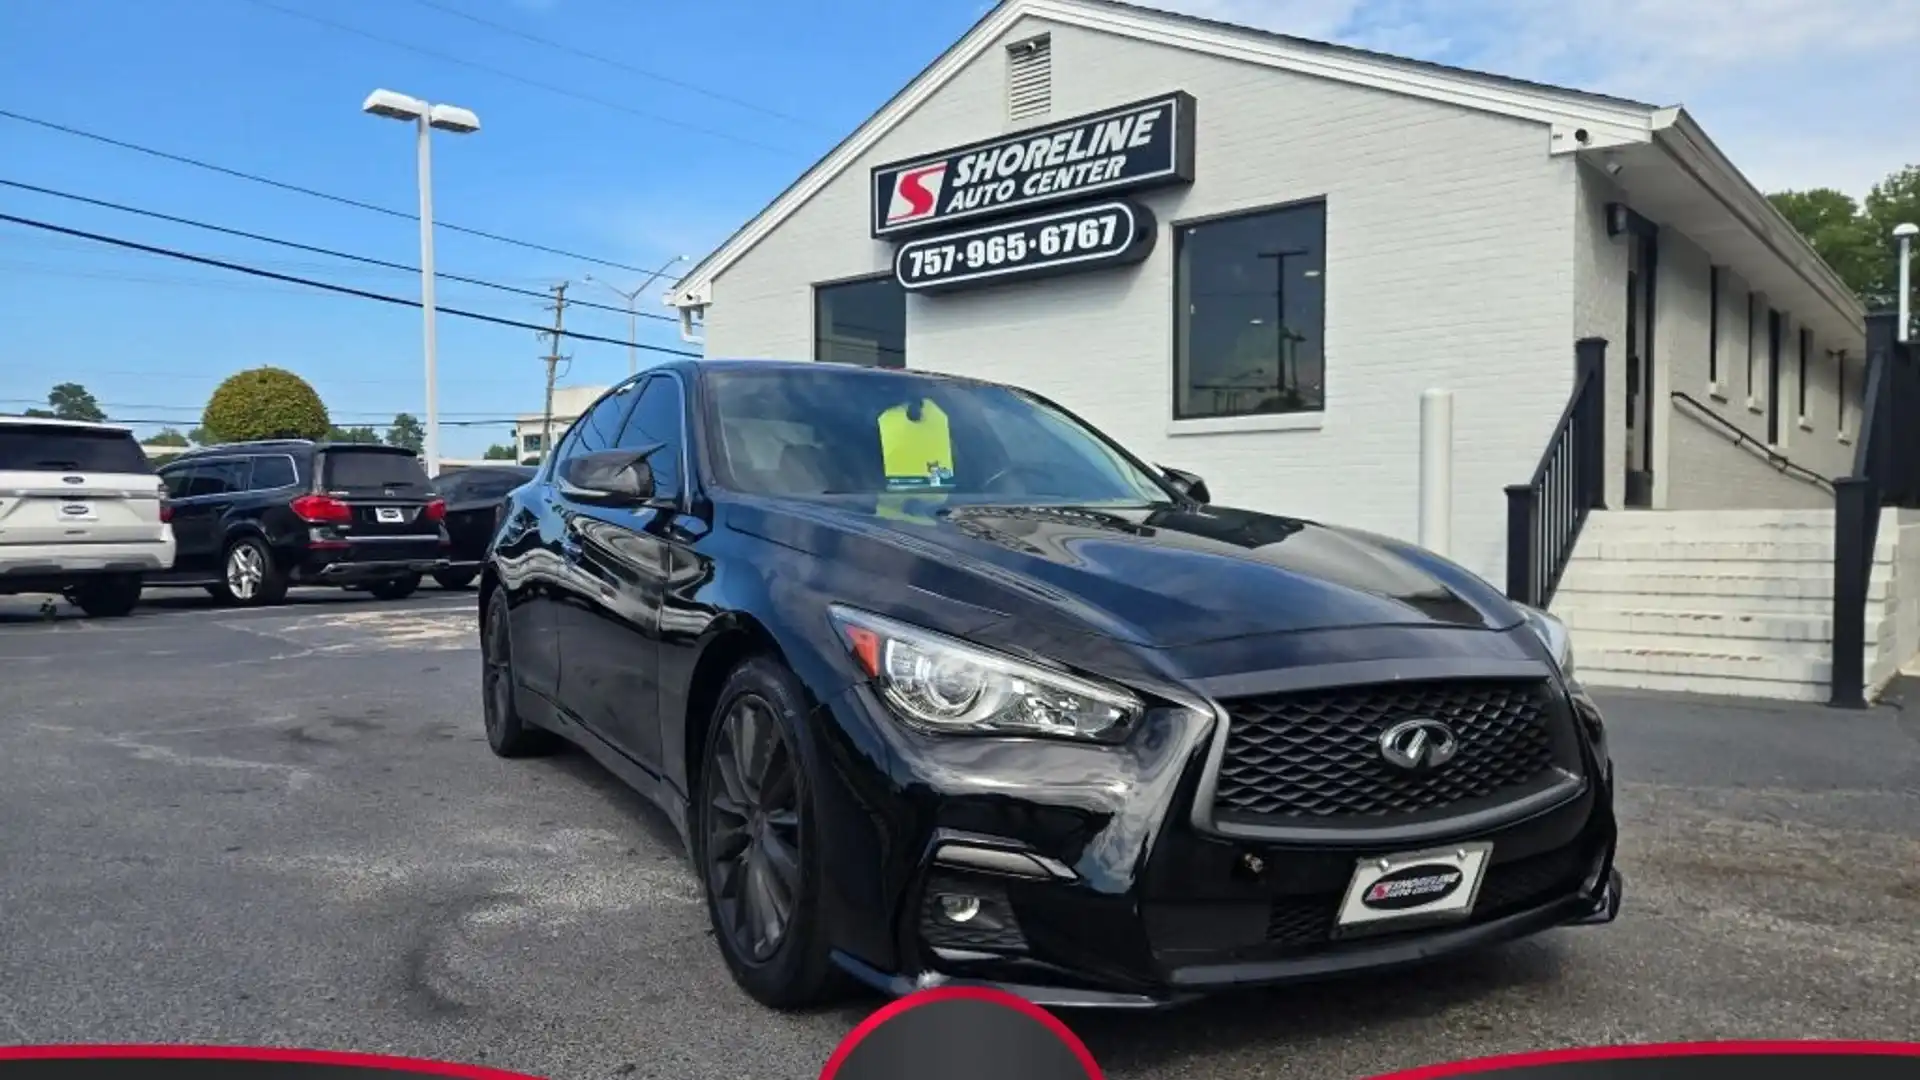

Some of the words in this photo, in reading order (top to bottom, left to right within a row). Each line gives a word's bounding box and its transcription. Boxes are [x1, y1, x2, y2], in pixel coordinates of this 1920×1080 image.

[953, 110, 1161, 187] SHORELINE
[946, 181, 1014, 213] AUTO
[1022, 155, 1127, 195] CENTER
